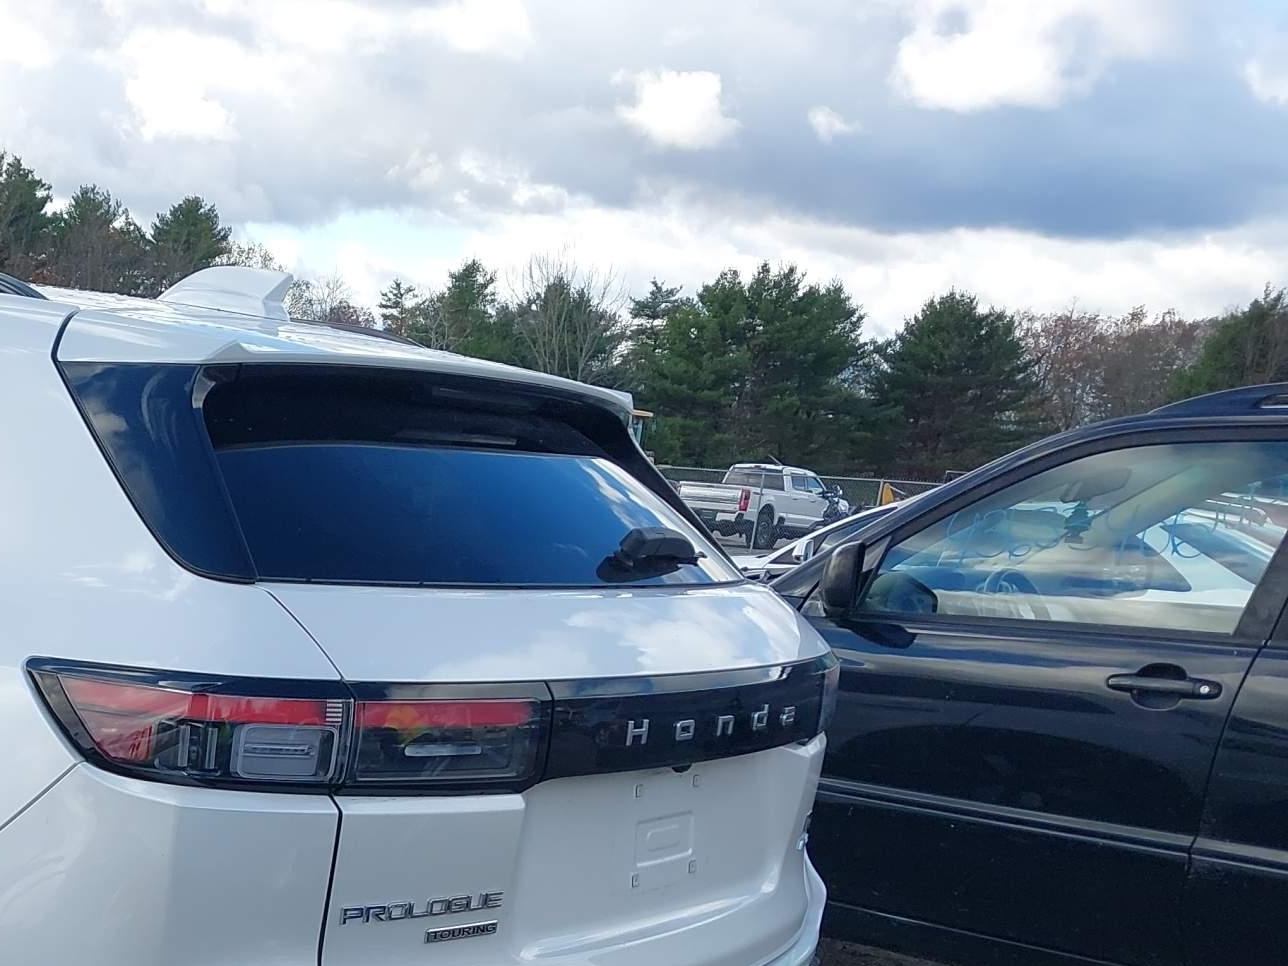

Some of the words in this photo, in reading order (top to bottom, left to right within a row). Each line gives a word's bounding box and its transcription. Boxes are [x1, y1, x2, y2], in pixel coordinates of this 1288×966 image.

[626, 703, 797, 746] Honda
[341, 891, 504, 925] PROLOGUE
[431, 925, 497, 942] TOURING
